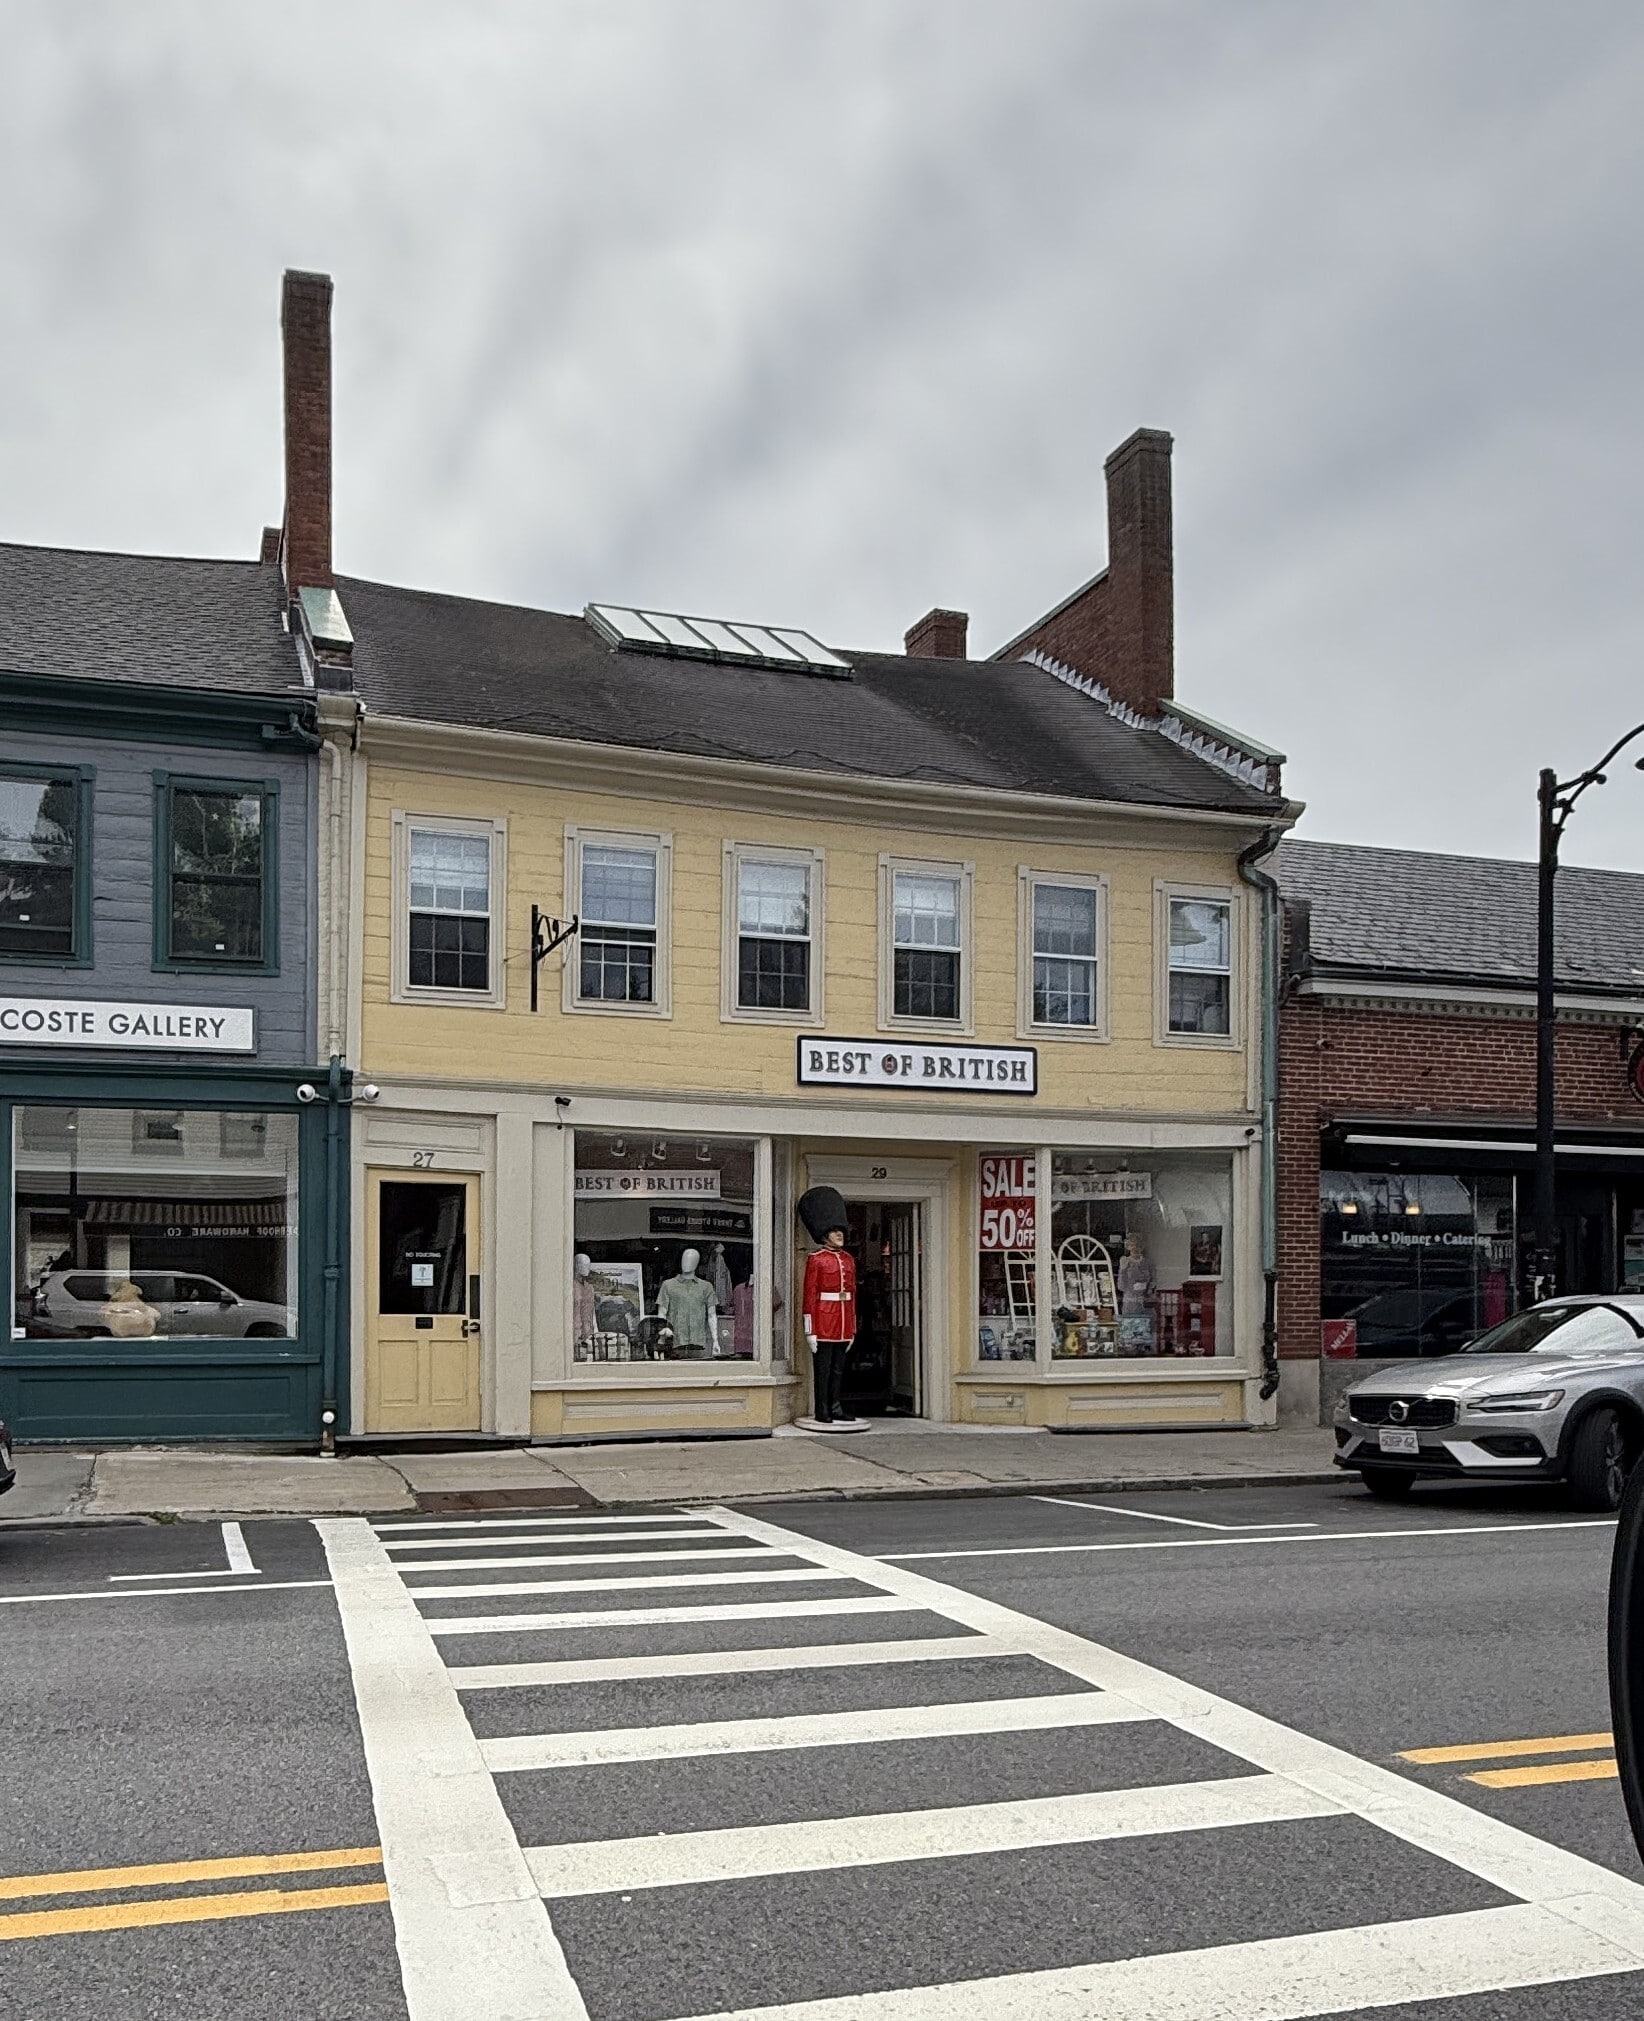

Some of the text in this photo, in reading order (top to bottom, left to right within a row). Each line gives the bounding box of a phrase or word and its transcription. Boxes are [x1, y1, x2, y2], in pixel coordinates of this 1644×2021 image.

[0, 1009, 226, 1039] COSTE GALLERY
[809, 1050, 1028, 1082] BEST OF BRITISH
[413, 1151, 435, 1168] 27
[871, 1167, 887, 1180] 29
[982, 1158, 1036, 1199] SALE
[575, 1176, 716, 1191] BEST OF BRITISH
[1016, 1229, 1036, 1247] OFF
[1342, 1230, 1491, 1248] Lunch Dinner Catering
